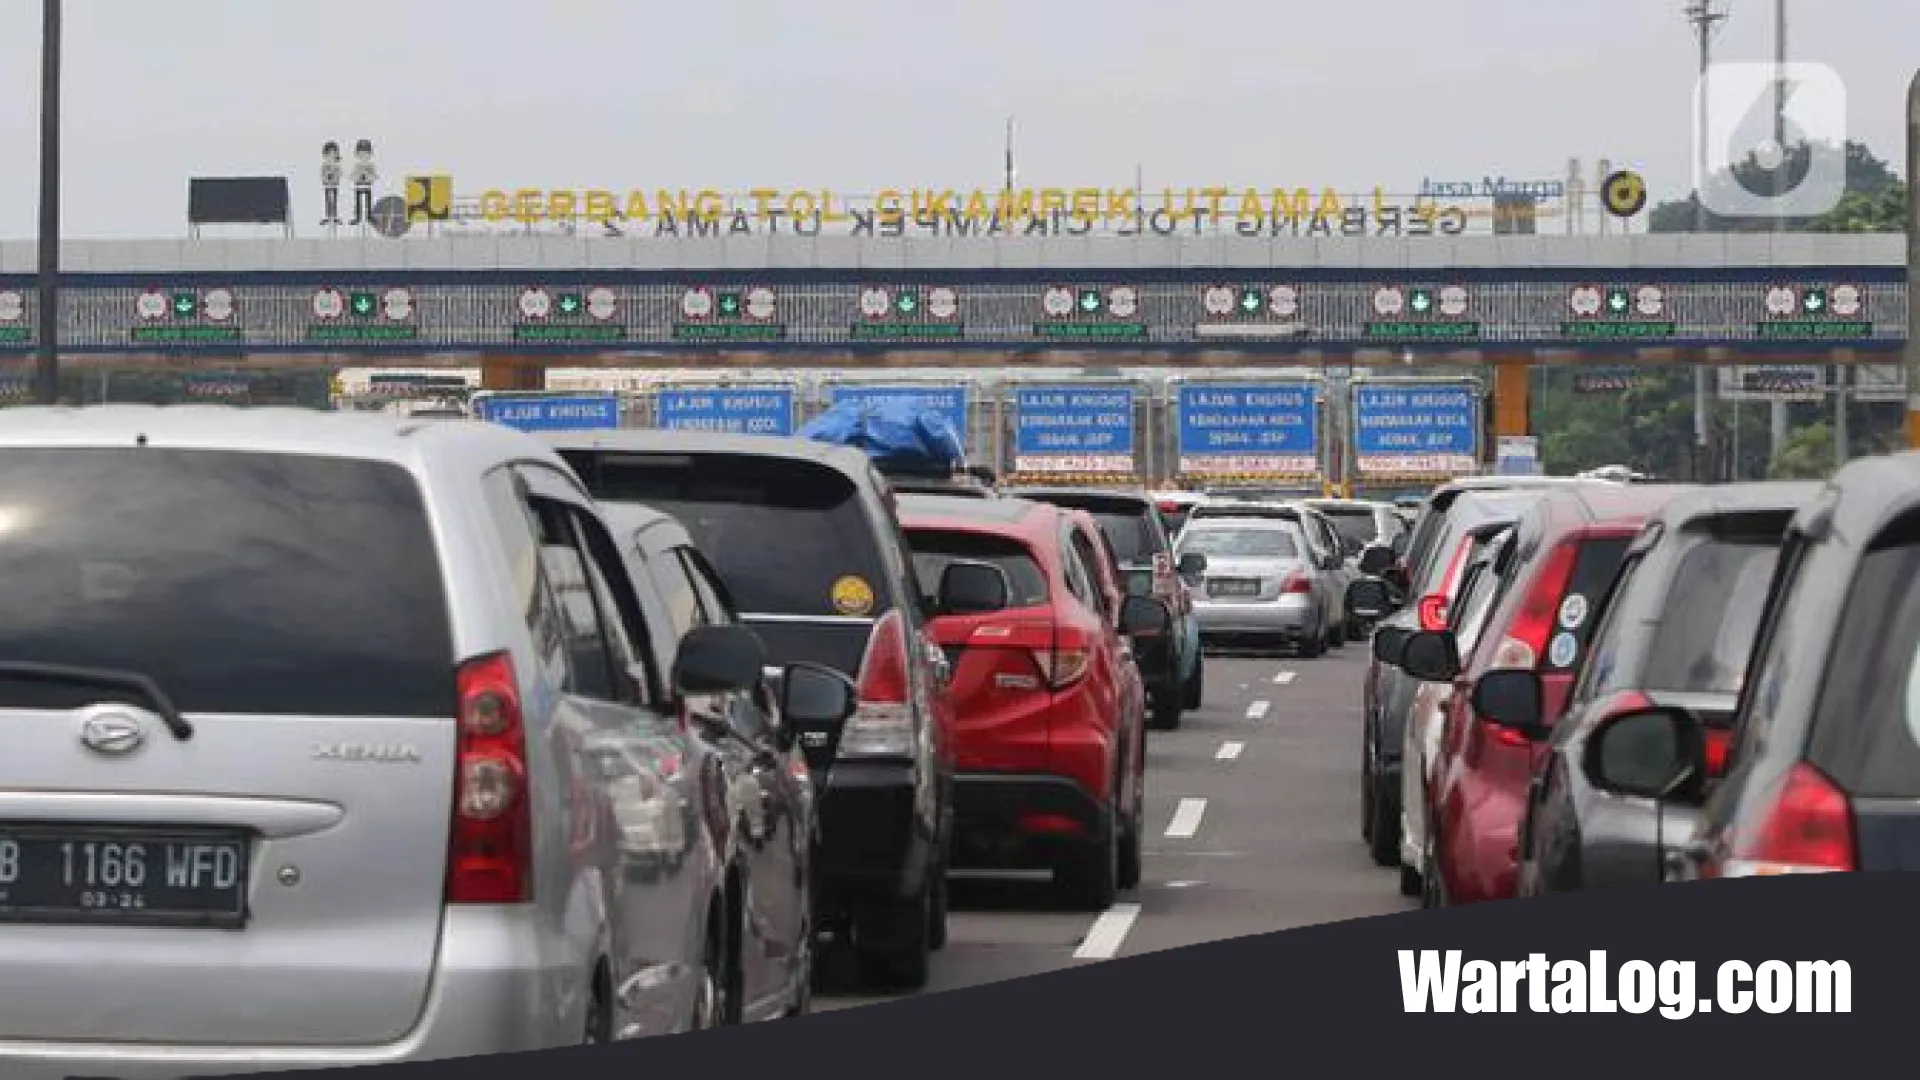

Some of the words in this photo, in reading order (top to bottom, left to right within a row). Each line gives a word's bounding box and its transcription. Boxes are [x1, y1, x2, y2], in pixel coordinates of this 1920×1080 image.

[480, 187, 724, 221] GERBANG
[750, 188, 848, 222] TOL
[875, 188, 1136, 222] CIKAMPEK
[1163, 187, 1341, 221] UTAMA
[61, 842, 146, 887] 1166
[165, 845, 239, 890] WFD
